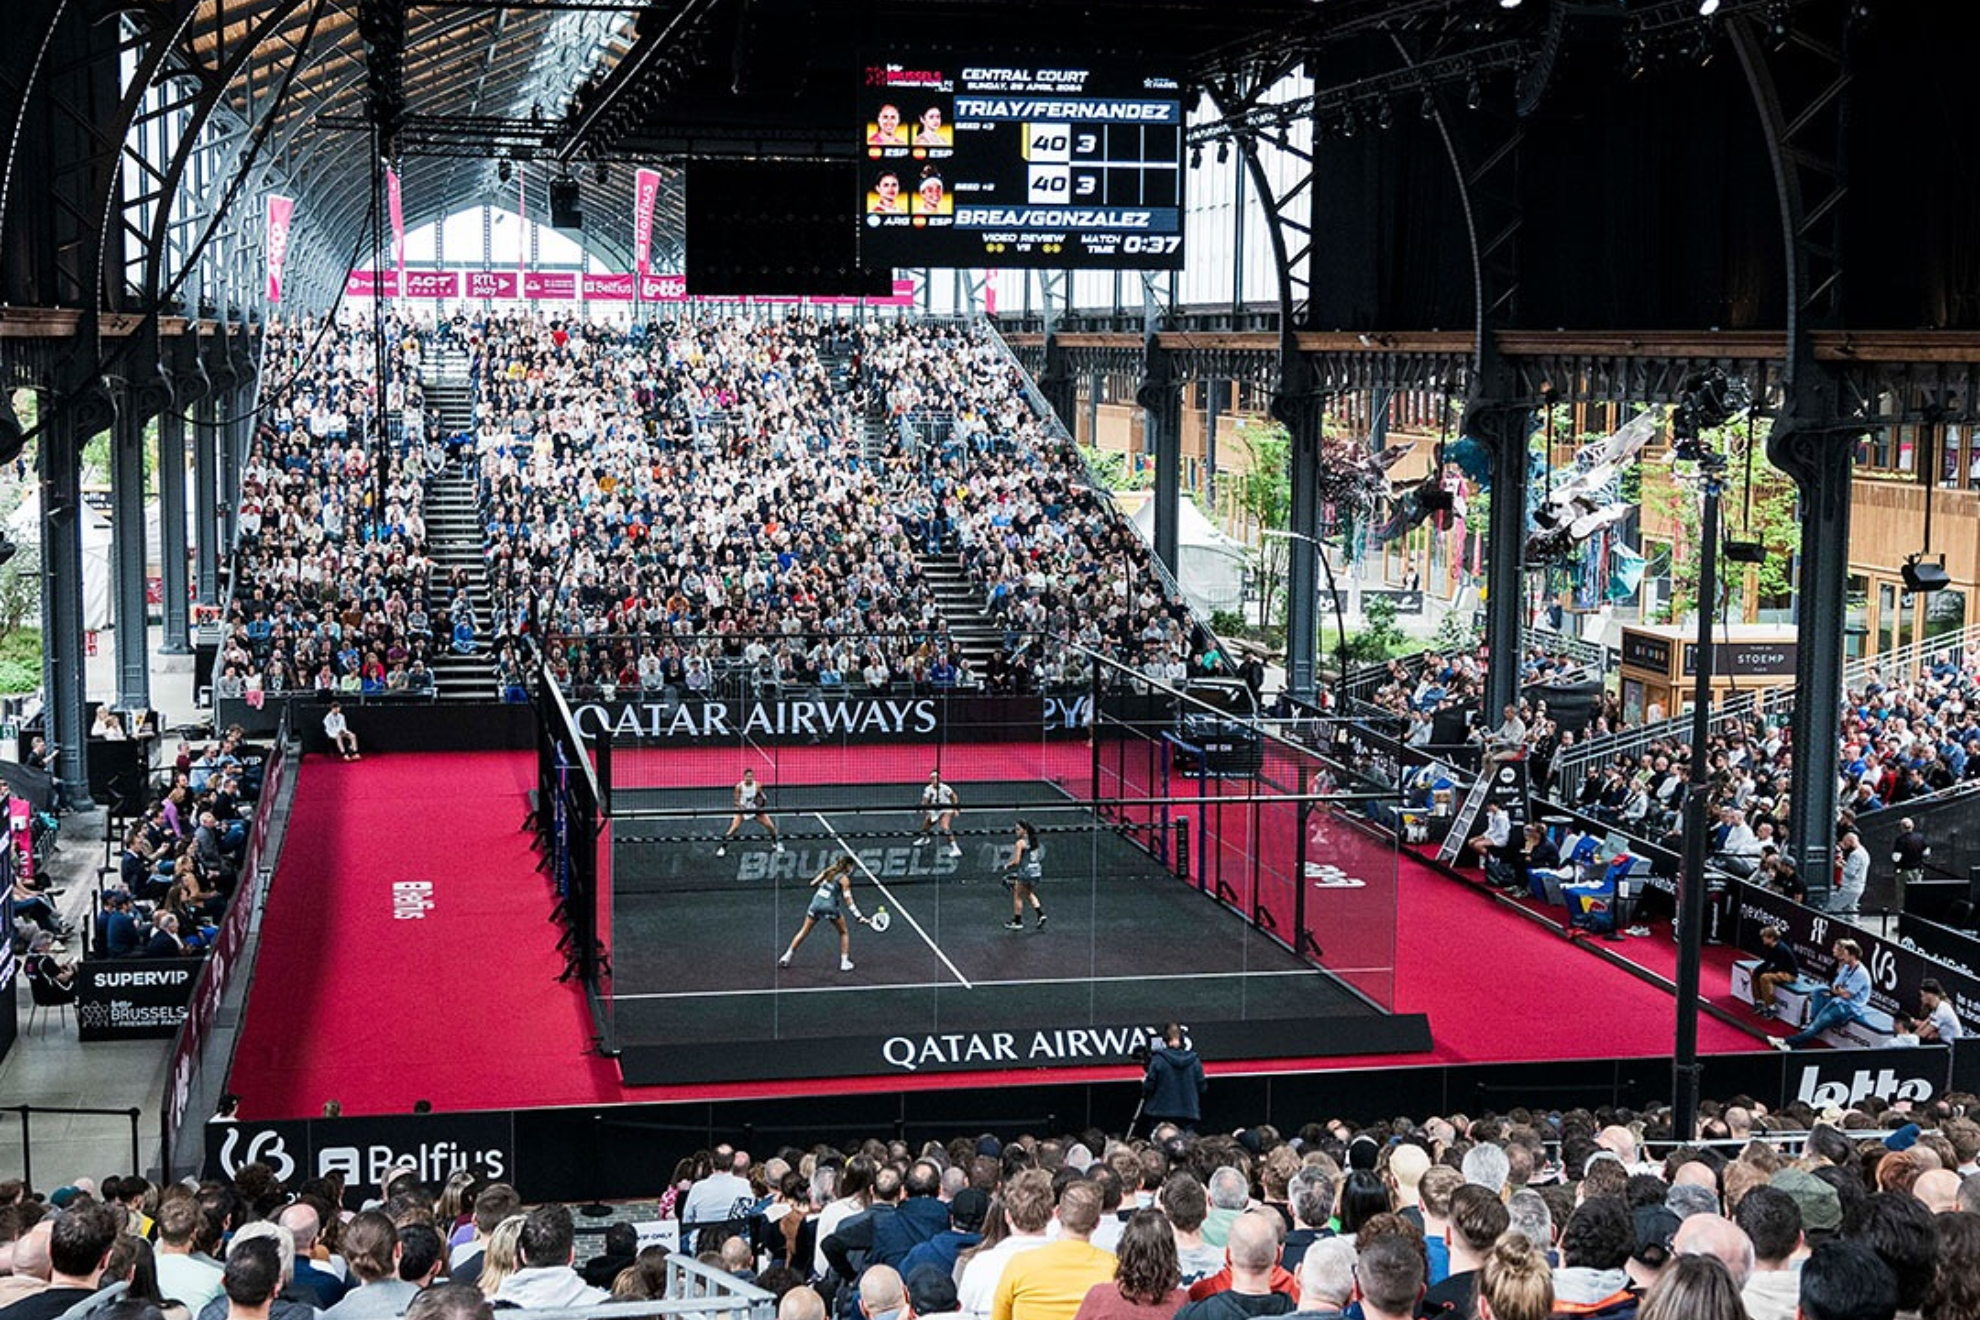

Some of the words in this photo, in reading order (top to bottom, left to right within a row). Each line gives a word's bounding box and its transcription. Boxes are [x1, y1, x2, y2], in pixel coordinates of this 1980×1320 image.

[961, 68, 1032, 81] CENTRAL
[1036, 71, 1089, 83] COURT
[956, 100, 1171, 120] TRIAY/FERNANDEZ
[1032, 135, 1067, 151] 40
[1076, 134, 1097, 153] 3
[884, 148, 909, 158] ESP
[928, 149, 953, 158] ESP
[1032, 176, 1067, 192] 40
[1075, 176, 1097, 195] 3
[928, 218, 953, 227] ESP
[955, 210, 1151, 227] BREA/GONZALEZ
[982, 233, 1017, 243] VIDEO
[1020, 233, 1066, 243] REVIEW
[1081, 234, 1121, 244] MATCH
[1123, 236, 1181, 254] 0:37
[1087, 245, 1116, 254] TIME
[1737, 654, 1785, 664] STOEMP
[573, 703, 730, 740] QATAR
[742, 700, 937, 735] AIRWAYS
[94, 970, 189, 987] SUPERVIP
[111, 1006, 186, 1021] BRUSSELS
[883, 1033, 1017, 1070] QATAR
[1029, 1025, 1193, 1059] AIRWAS
[1798, 1065, 1933, 1110] lotto
